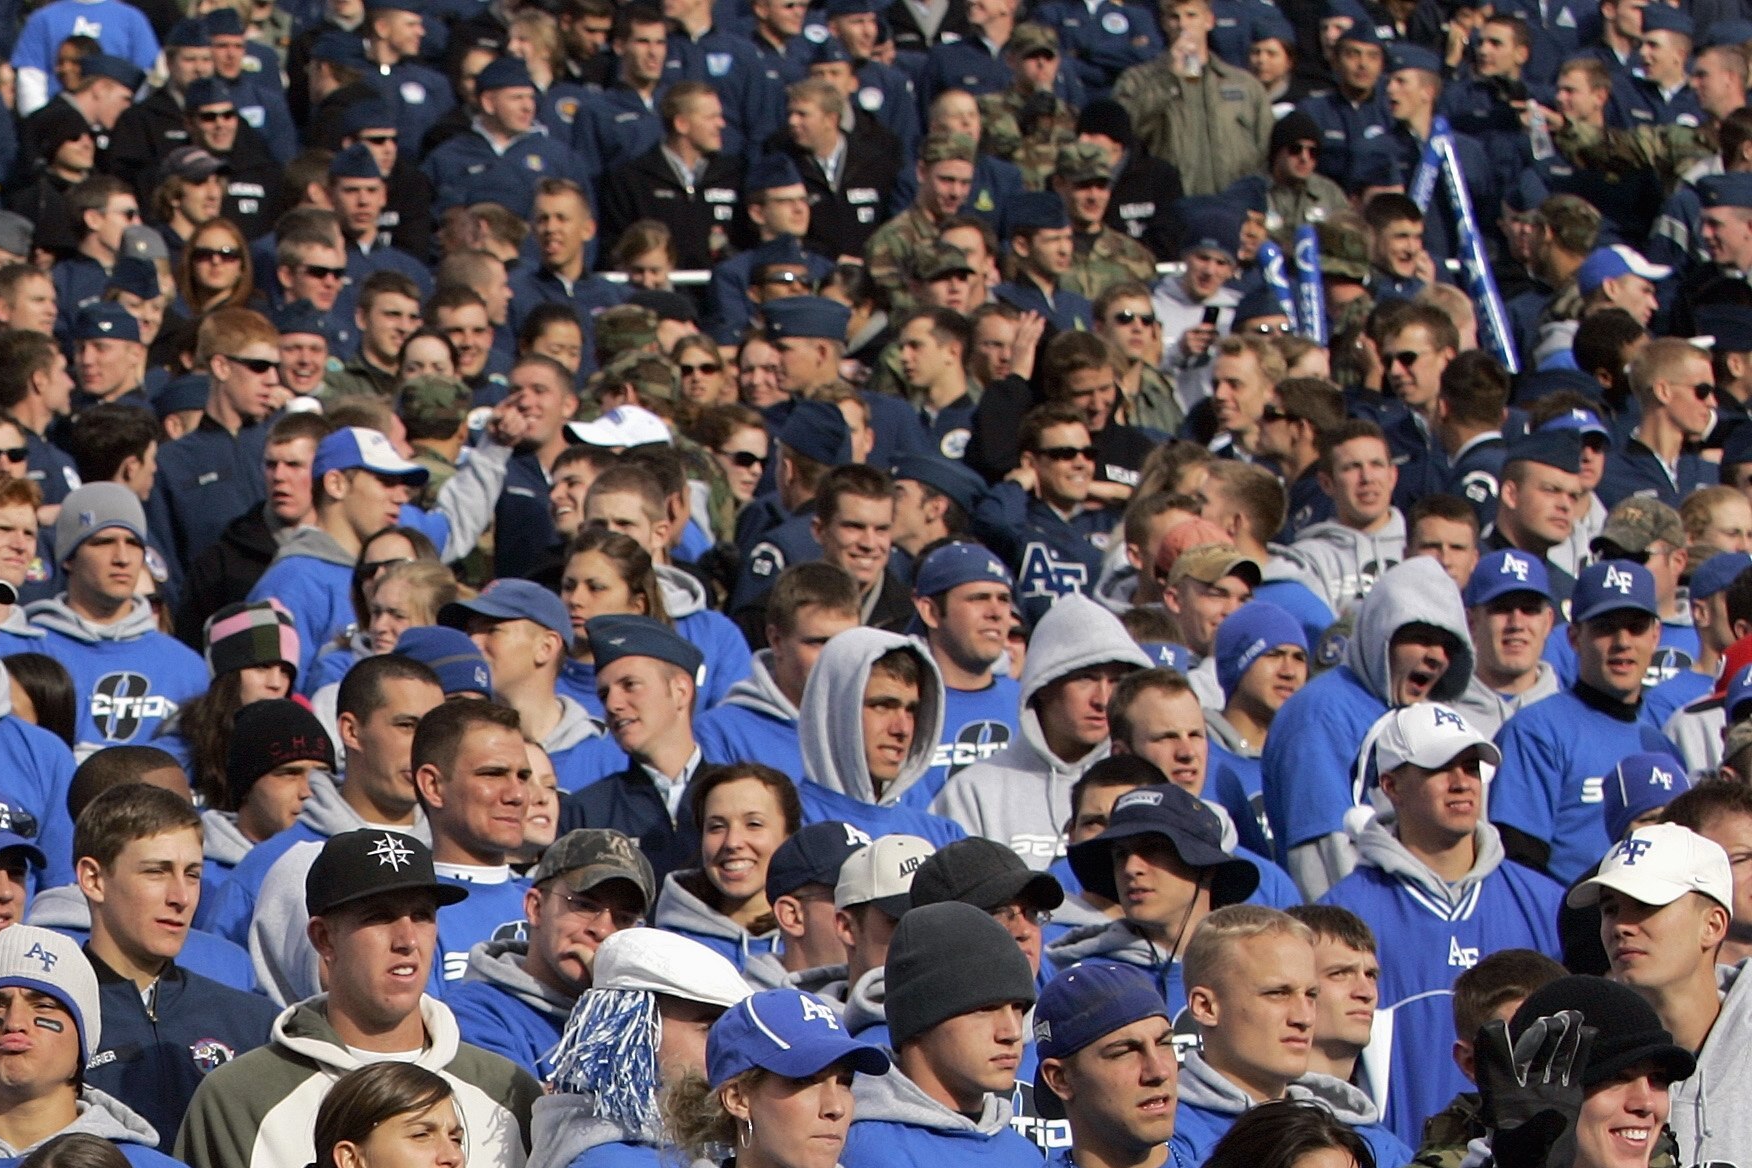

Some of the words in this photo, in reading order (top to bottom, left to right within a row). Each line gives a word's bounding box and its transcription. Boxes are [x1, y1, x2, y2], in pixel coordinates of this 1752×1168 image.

[1019, 541, 1088, 608] AF
[1501, 552, 1529, 582] AF
[1602, 564, 1633, 595] AF
[1649, 766, 1673, 790] AF
[24, 942, 58, 973] AF
[1448, 935, 1479, 968] AF
[800, 994, 840, 1029] AF
